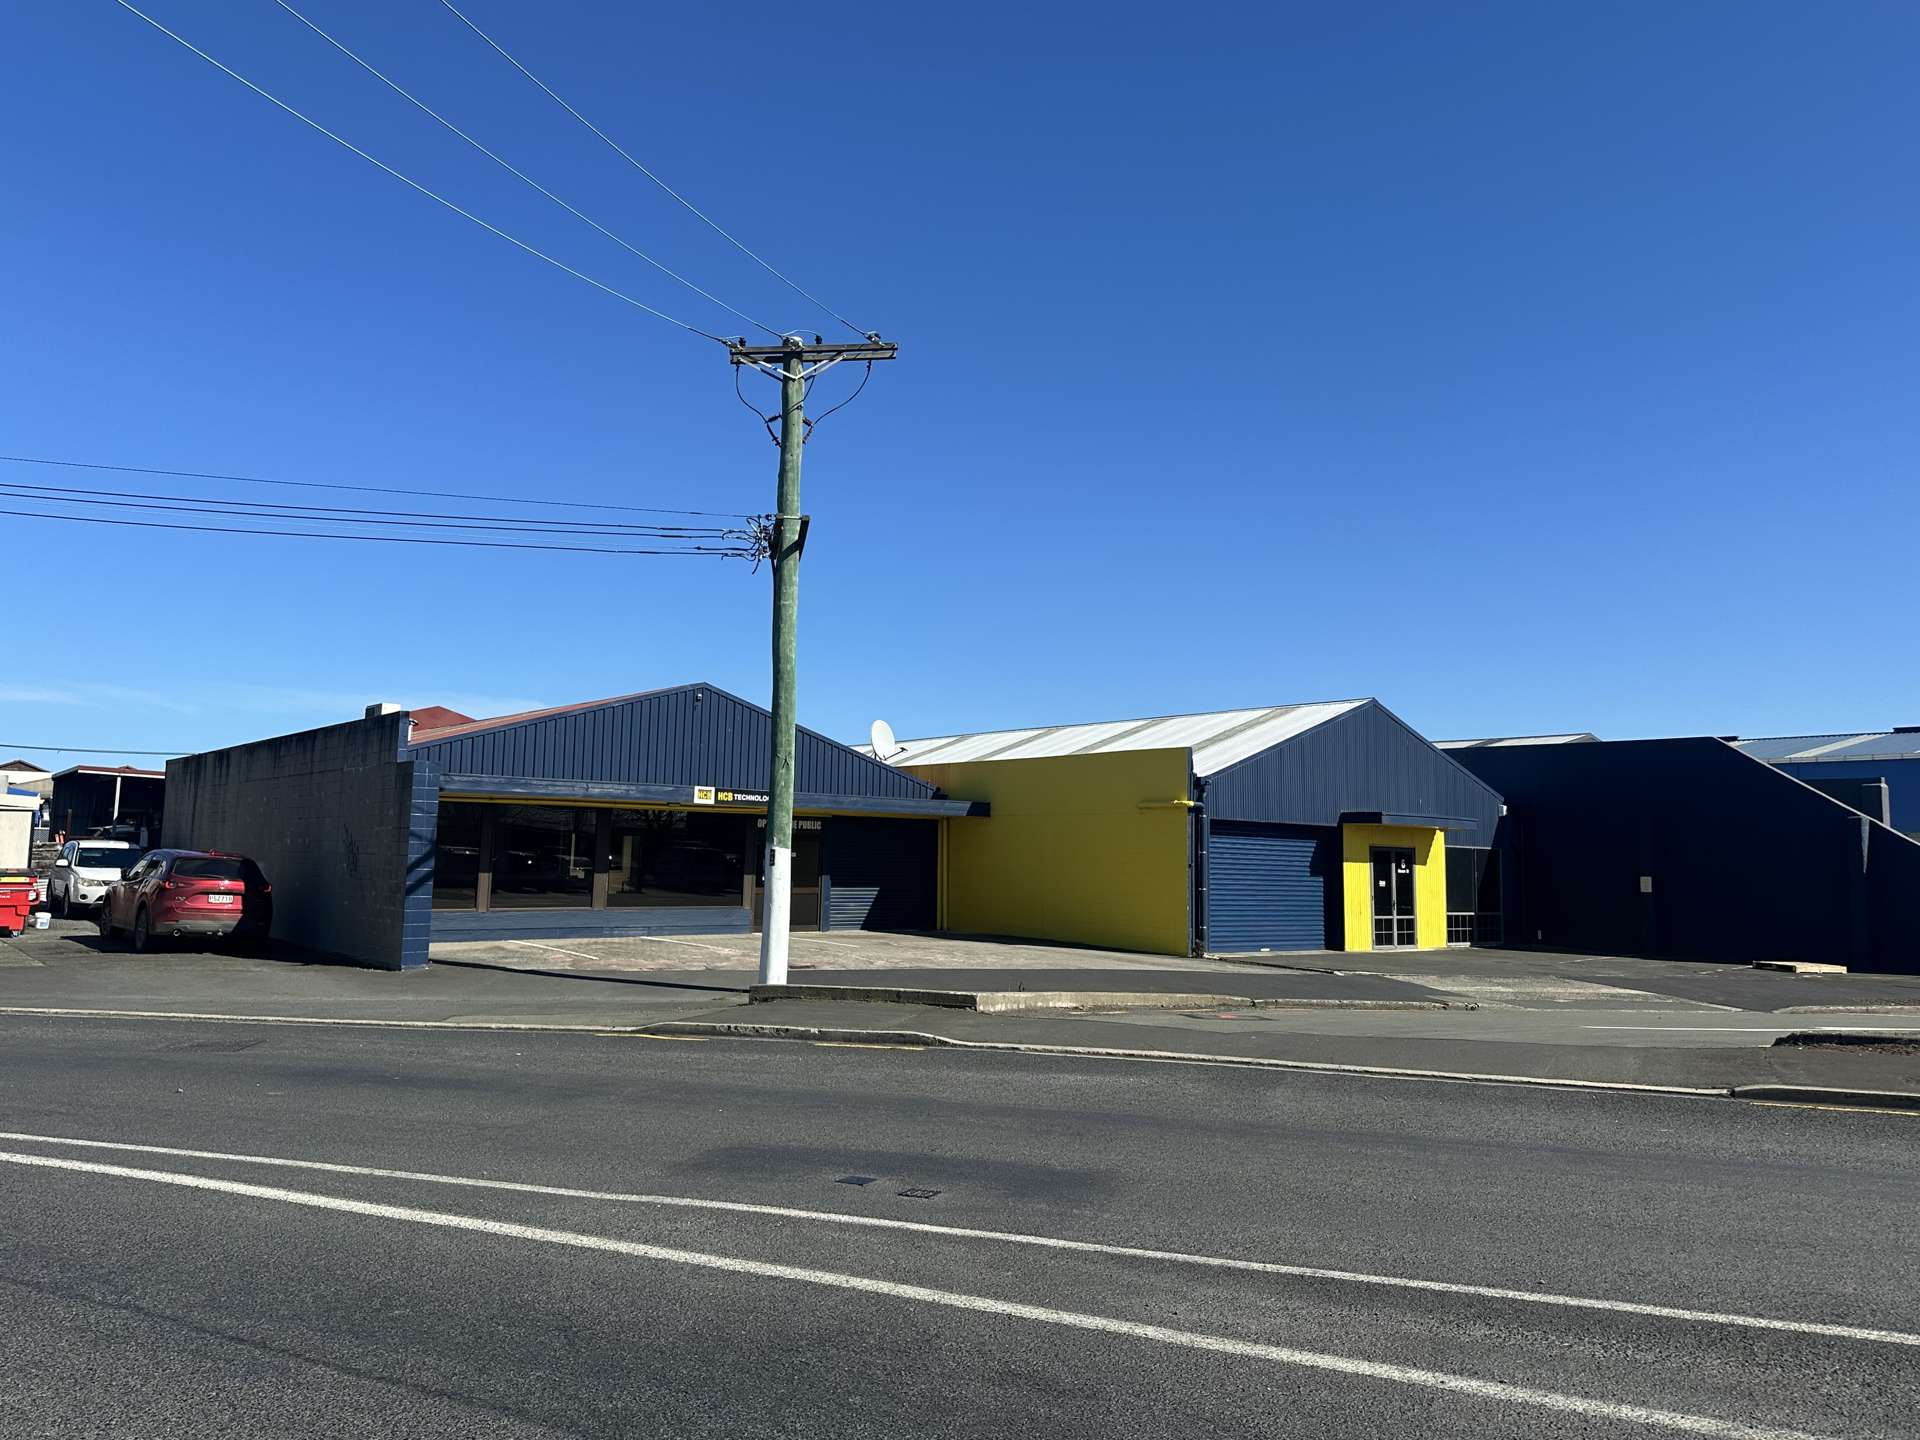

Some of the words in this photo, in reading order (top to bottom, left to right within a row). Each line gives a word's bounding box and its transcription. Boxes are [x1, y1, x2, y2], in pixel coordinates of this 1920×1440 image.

[698, 789, 712, 799] HCB
[717, 791, 733, 801] HCB
[733, 794, 769, 802] TECHNOLO
[798, 820, 822, 830] PUBLIC
